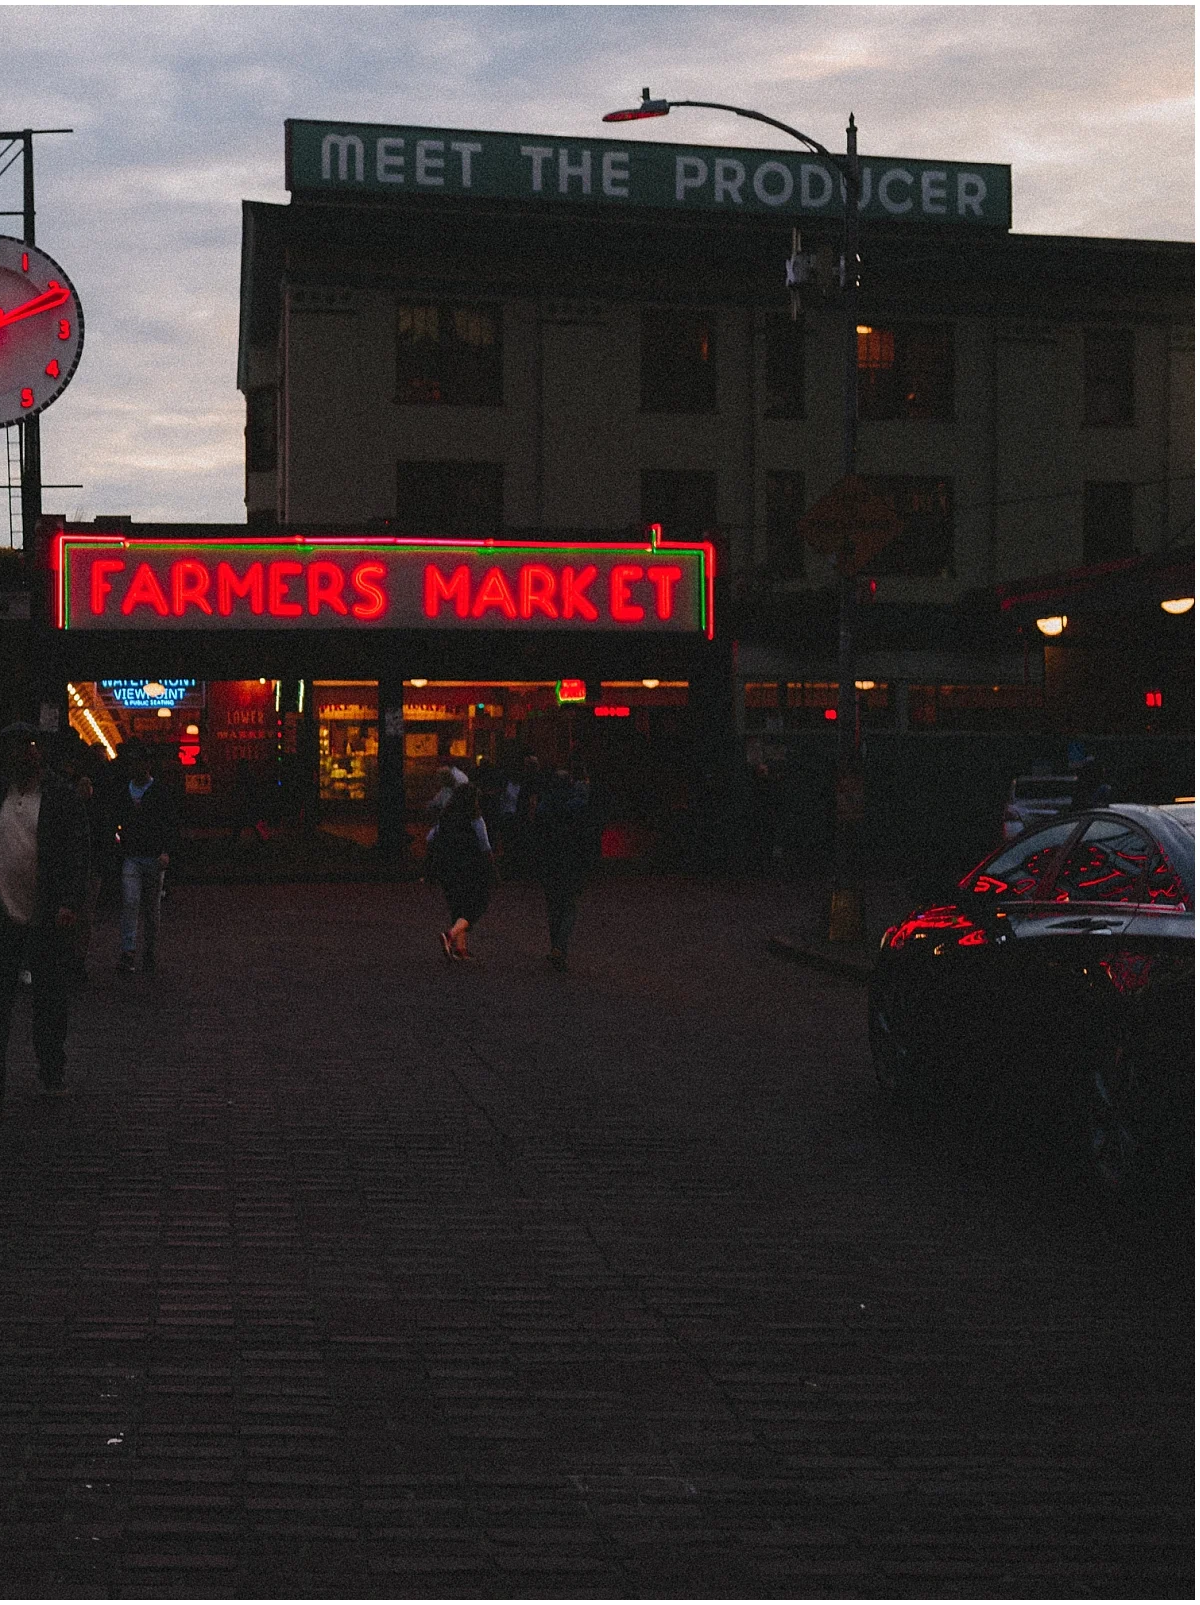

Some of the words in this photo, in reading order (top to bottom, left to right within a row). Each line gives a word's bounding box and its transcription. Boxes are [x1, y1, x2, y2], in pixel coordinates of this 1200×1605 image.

[320, 132, 482, 188] MEET
[520, 145, 630, 197] THE
[675, 156, 987, 216] PRODUCER
[22, 253, 29, 272] 1
[58, 319, 71, 340] 3
[45, 359, 60, 379] 4
[21, 388, 34, 408] 5
[89, 560, 388, 619] FARMERS
[422, 563, 683, 621] MARKET
[227, 711, 264, 724] LOWER
